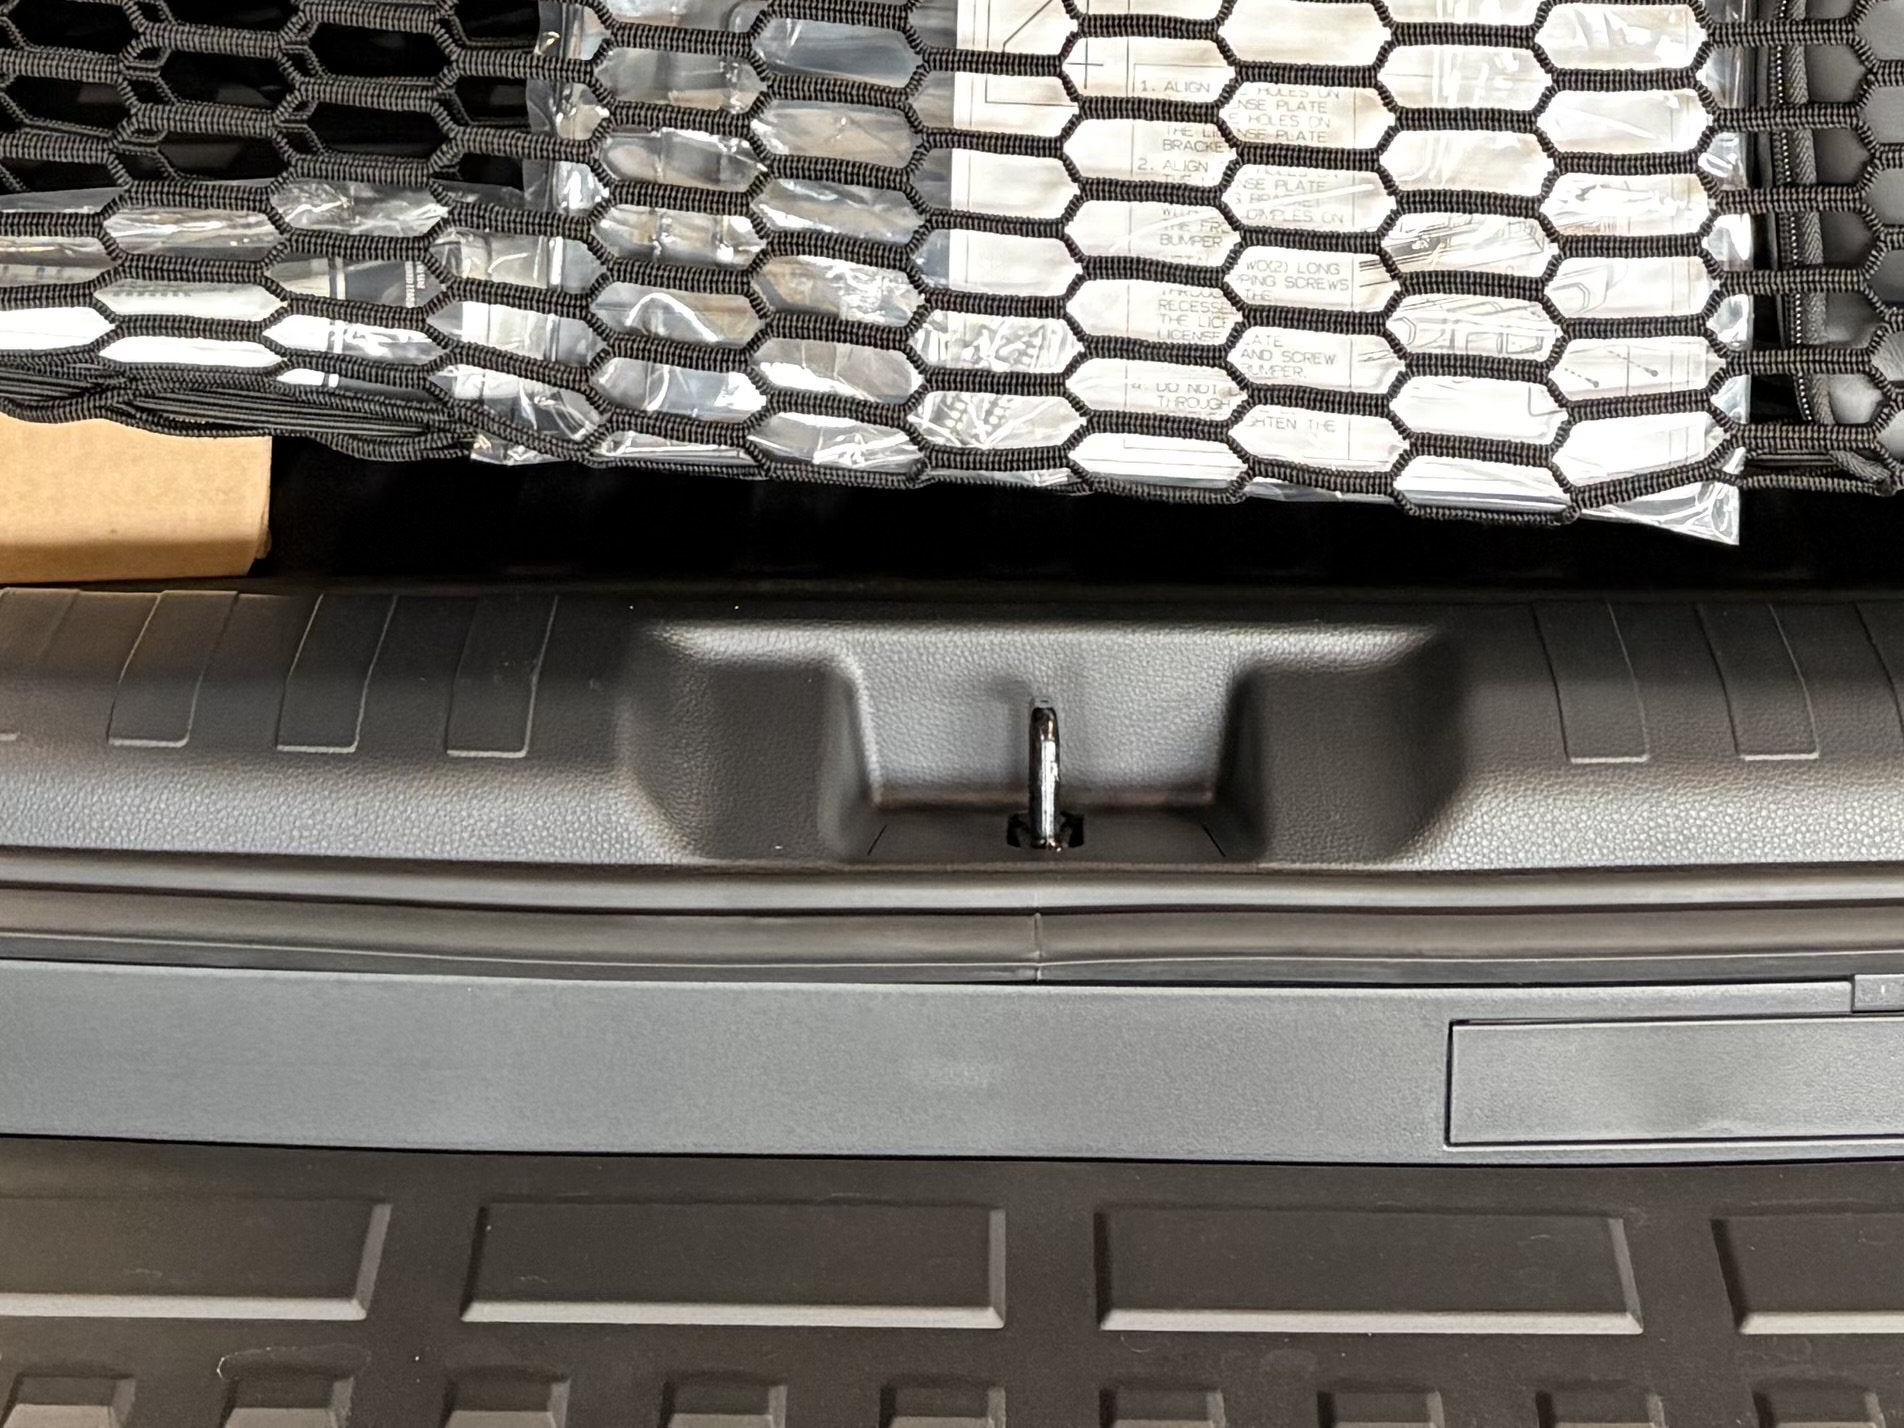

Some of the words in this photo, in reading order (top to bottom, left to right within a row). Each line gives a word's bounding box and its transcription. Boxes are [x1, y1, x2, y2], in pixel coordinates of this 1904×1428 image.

[1164, 81, 1210, 93] ALIGN
[1276, 99, 1328, 114] PLATE
[1276, 129, 1328, 143] PLATE
[1162, 139, 1231, 153] BRACKE
[1162, 160, 1209, 172] ALIGN
[1160, 233, 1223, 248] BUMPER
[1296, 262, 1341, 276] LONG
[1284, 276, 1350, 291] SCREWS
[1159, 299, 1228, 313] RECESSE
[1281, 350, 1336, 365] SCREW
